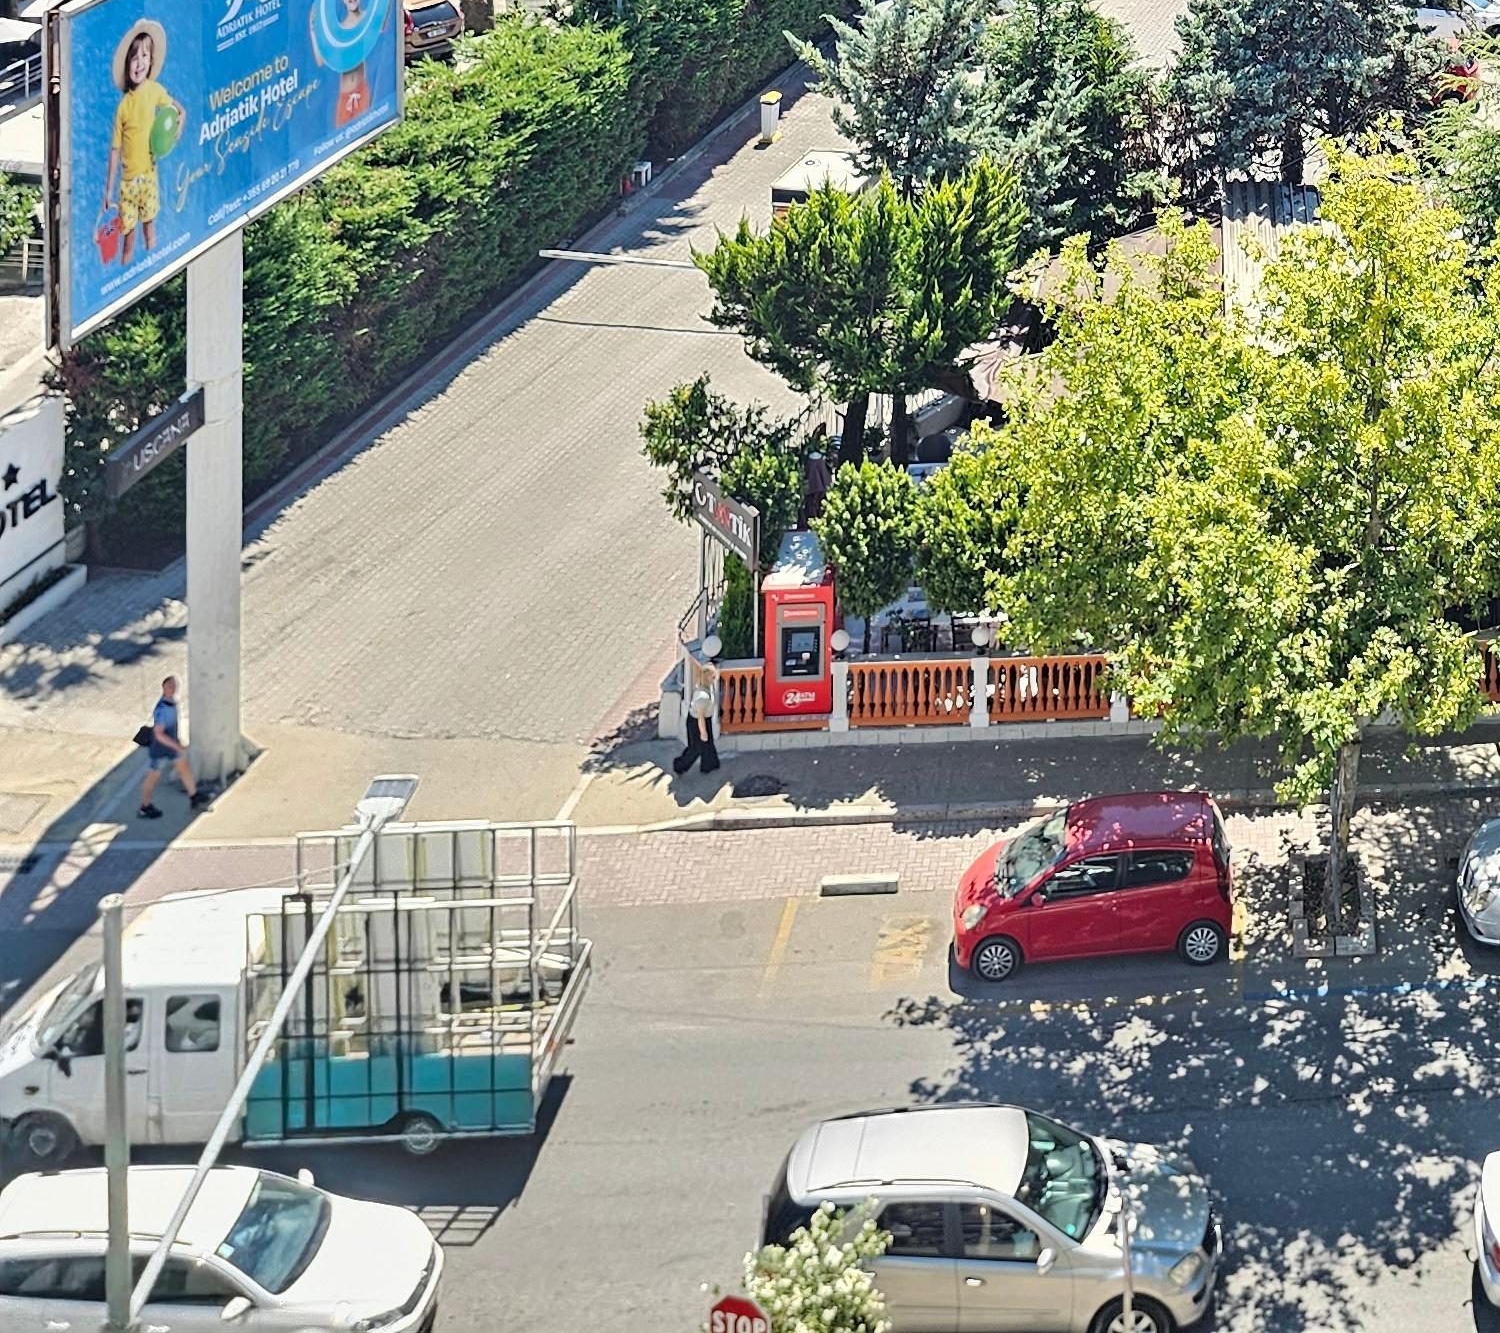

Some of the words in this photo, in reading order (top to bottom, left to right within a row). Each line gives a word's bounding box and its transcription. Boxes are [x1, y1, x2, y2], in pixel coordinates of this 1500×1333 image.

[199, 95, 259, 145] Adriatik
[261, 69, 298, 106] Hotel
[209, 64, 273, 110] Welcome
[275, 55, 289, 74] to
[712, 1309, 767, 1333] STOP
